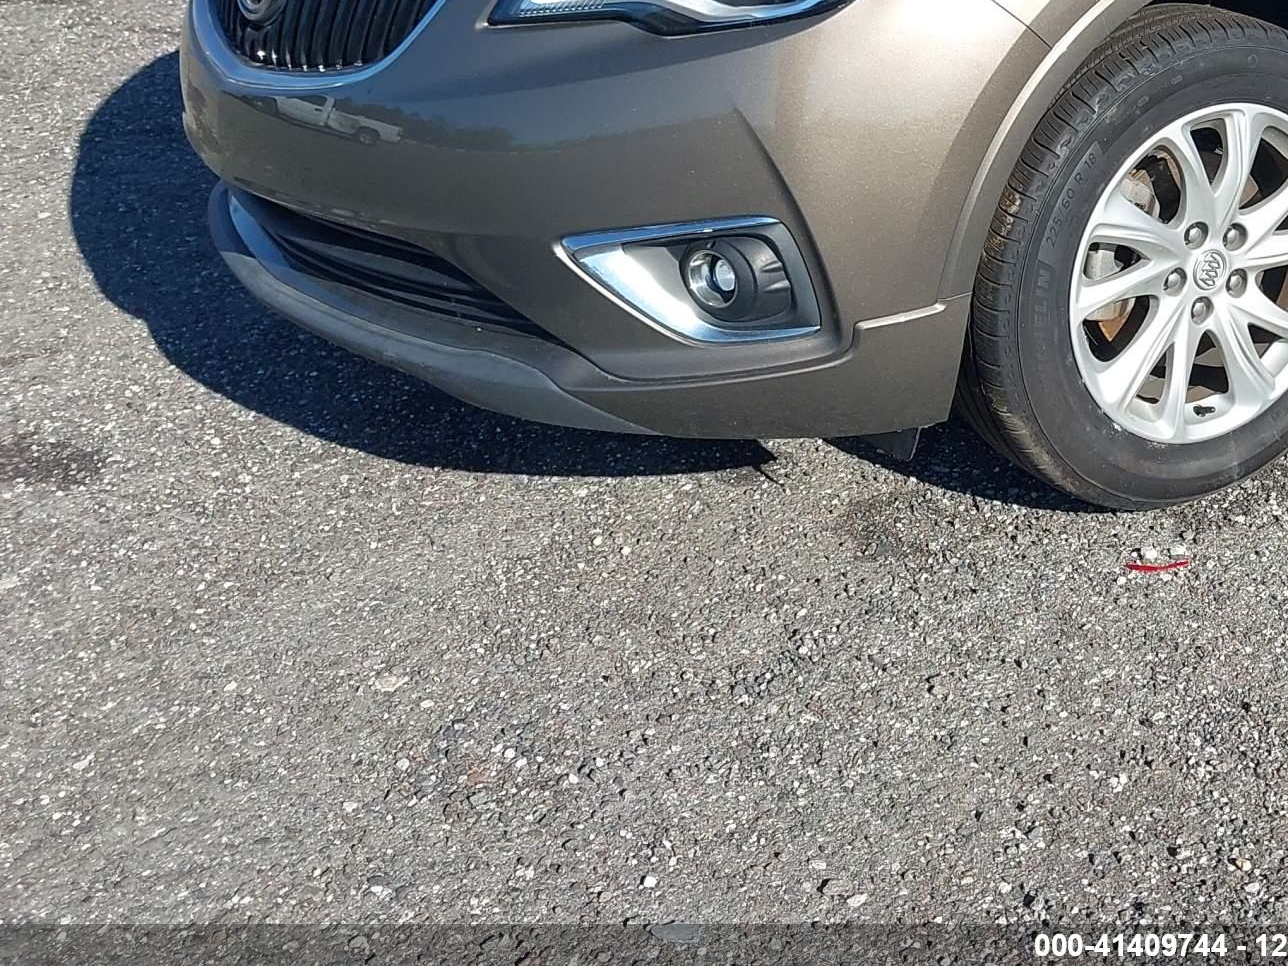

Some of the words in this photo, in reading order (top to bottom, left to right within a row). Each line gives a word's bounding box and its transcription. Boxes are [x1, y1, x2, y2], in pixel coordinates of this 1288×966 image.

[1046, 188, 1075, 248] 225/60
[1074, 172, 1088, 185] R
[1083, 153, 1098, 170] 18
